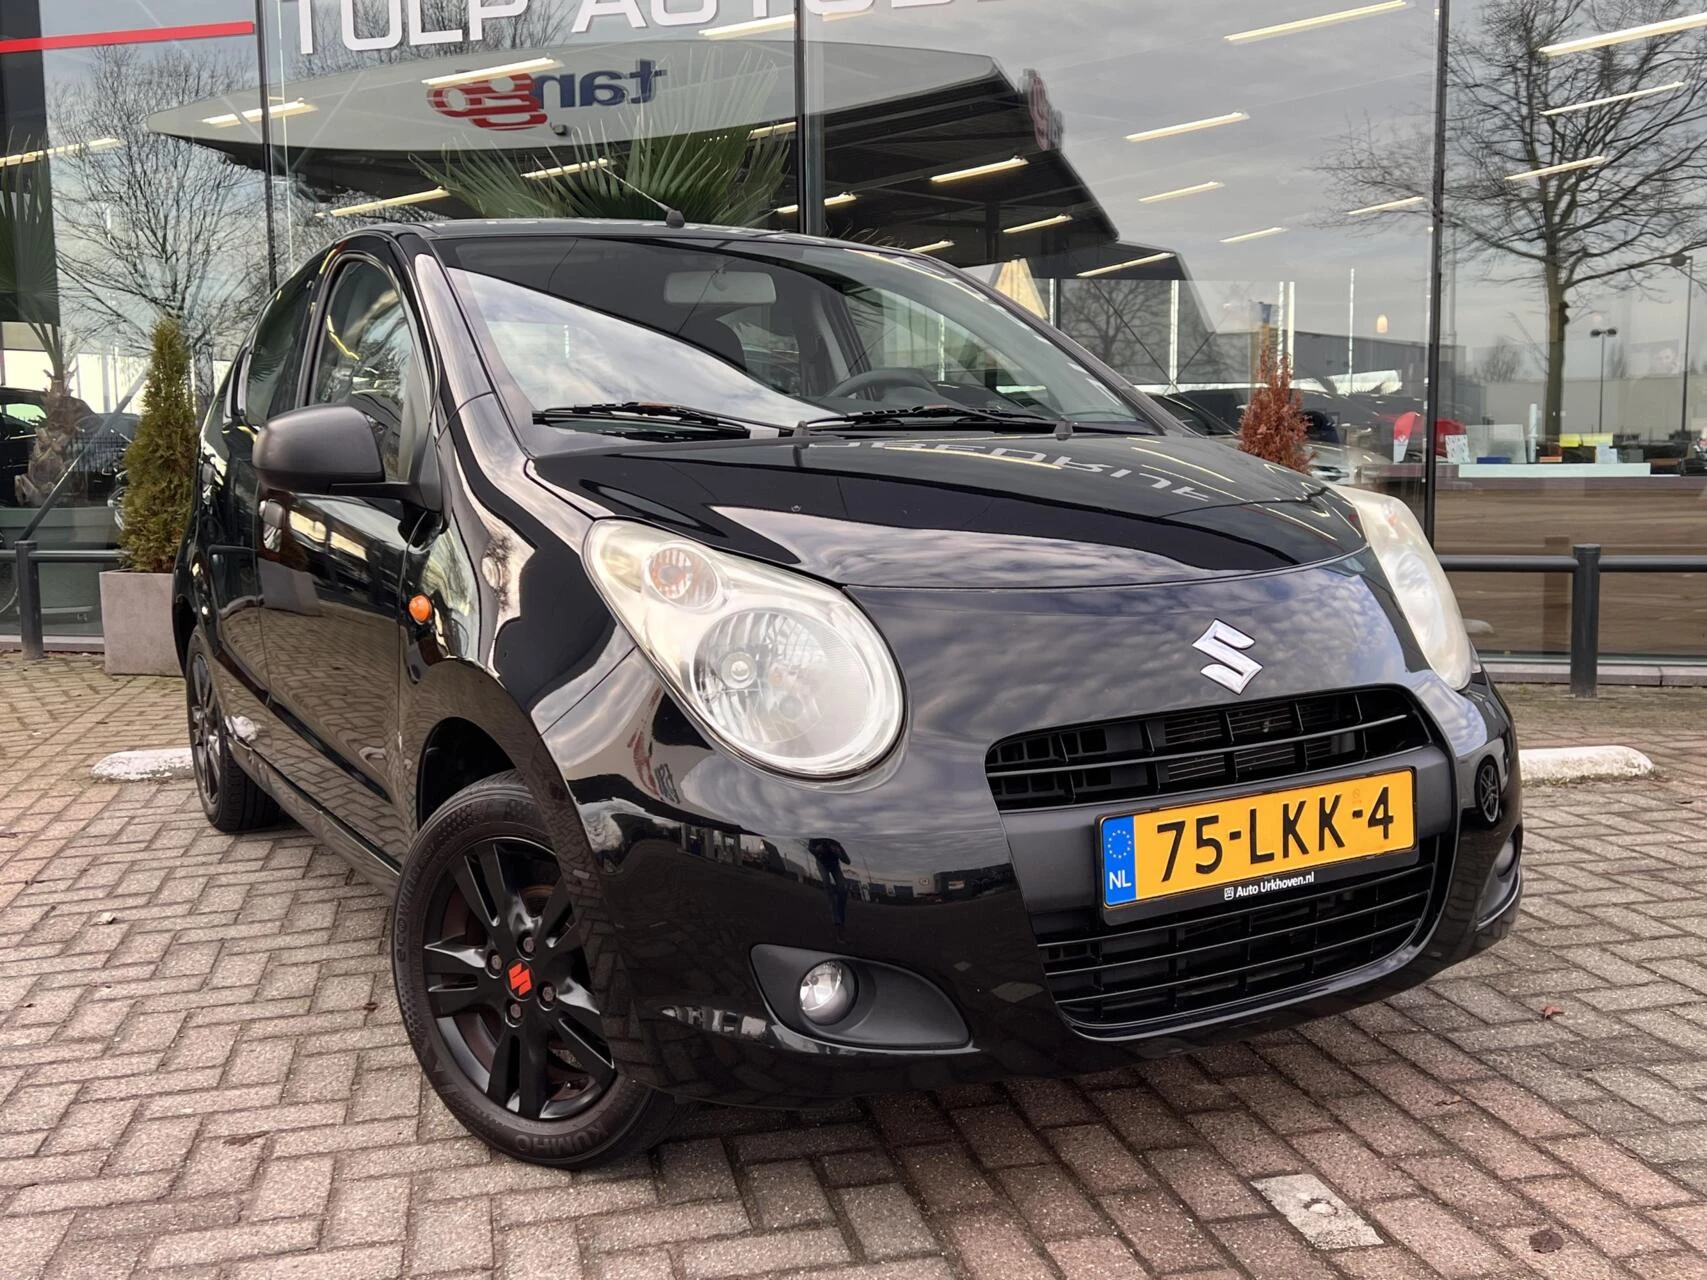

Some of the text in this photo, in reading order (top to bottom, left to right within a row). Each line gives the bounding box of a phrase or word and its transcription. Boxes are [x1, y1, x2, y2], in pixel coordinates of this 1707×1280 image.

[1157, 787, 1394, 883] 75-LKK-4
[1109, 870, 1132, 890] NL
[1236, 871, 1315, 898] Auto Urkhoven.nl
[514, 1121, 608, 1155] KUMHO
